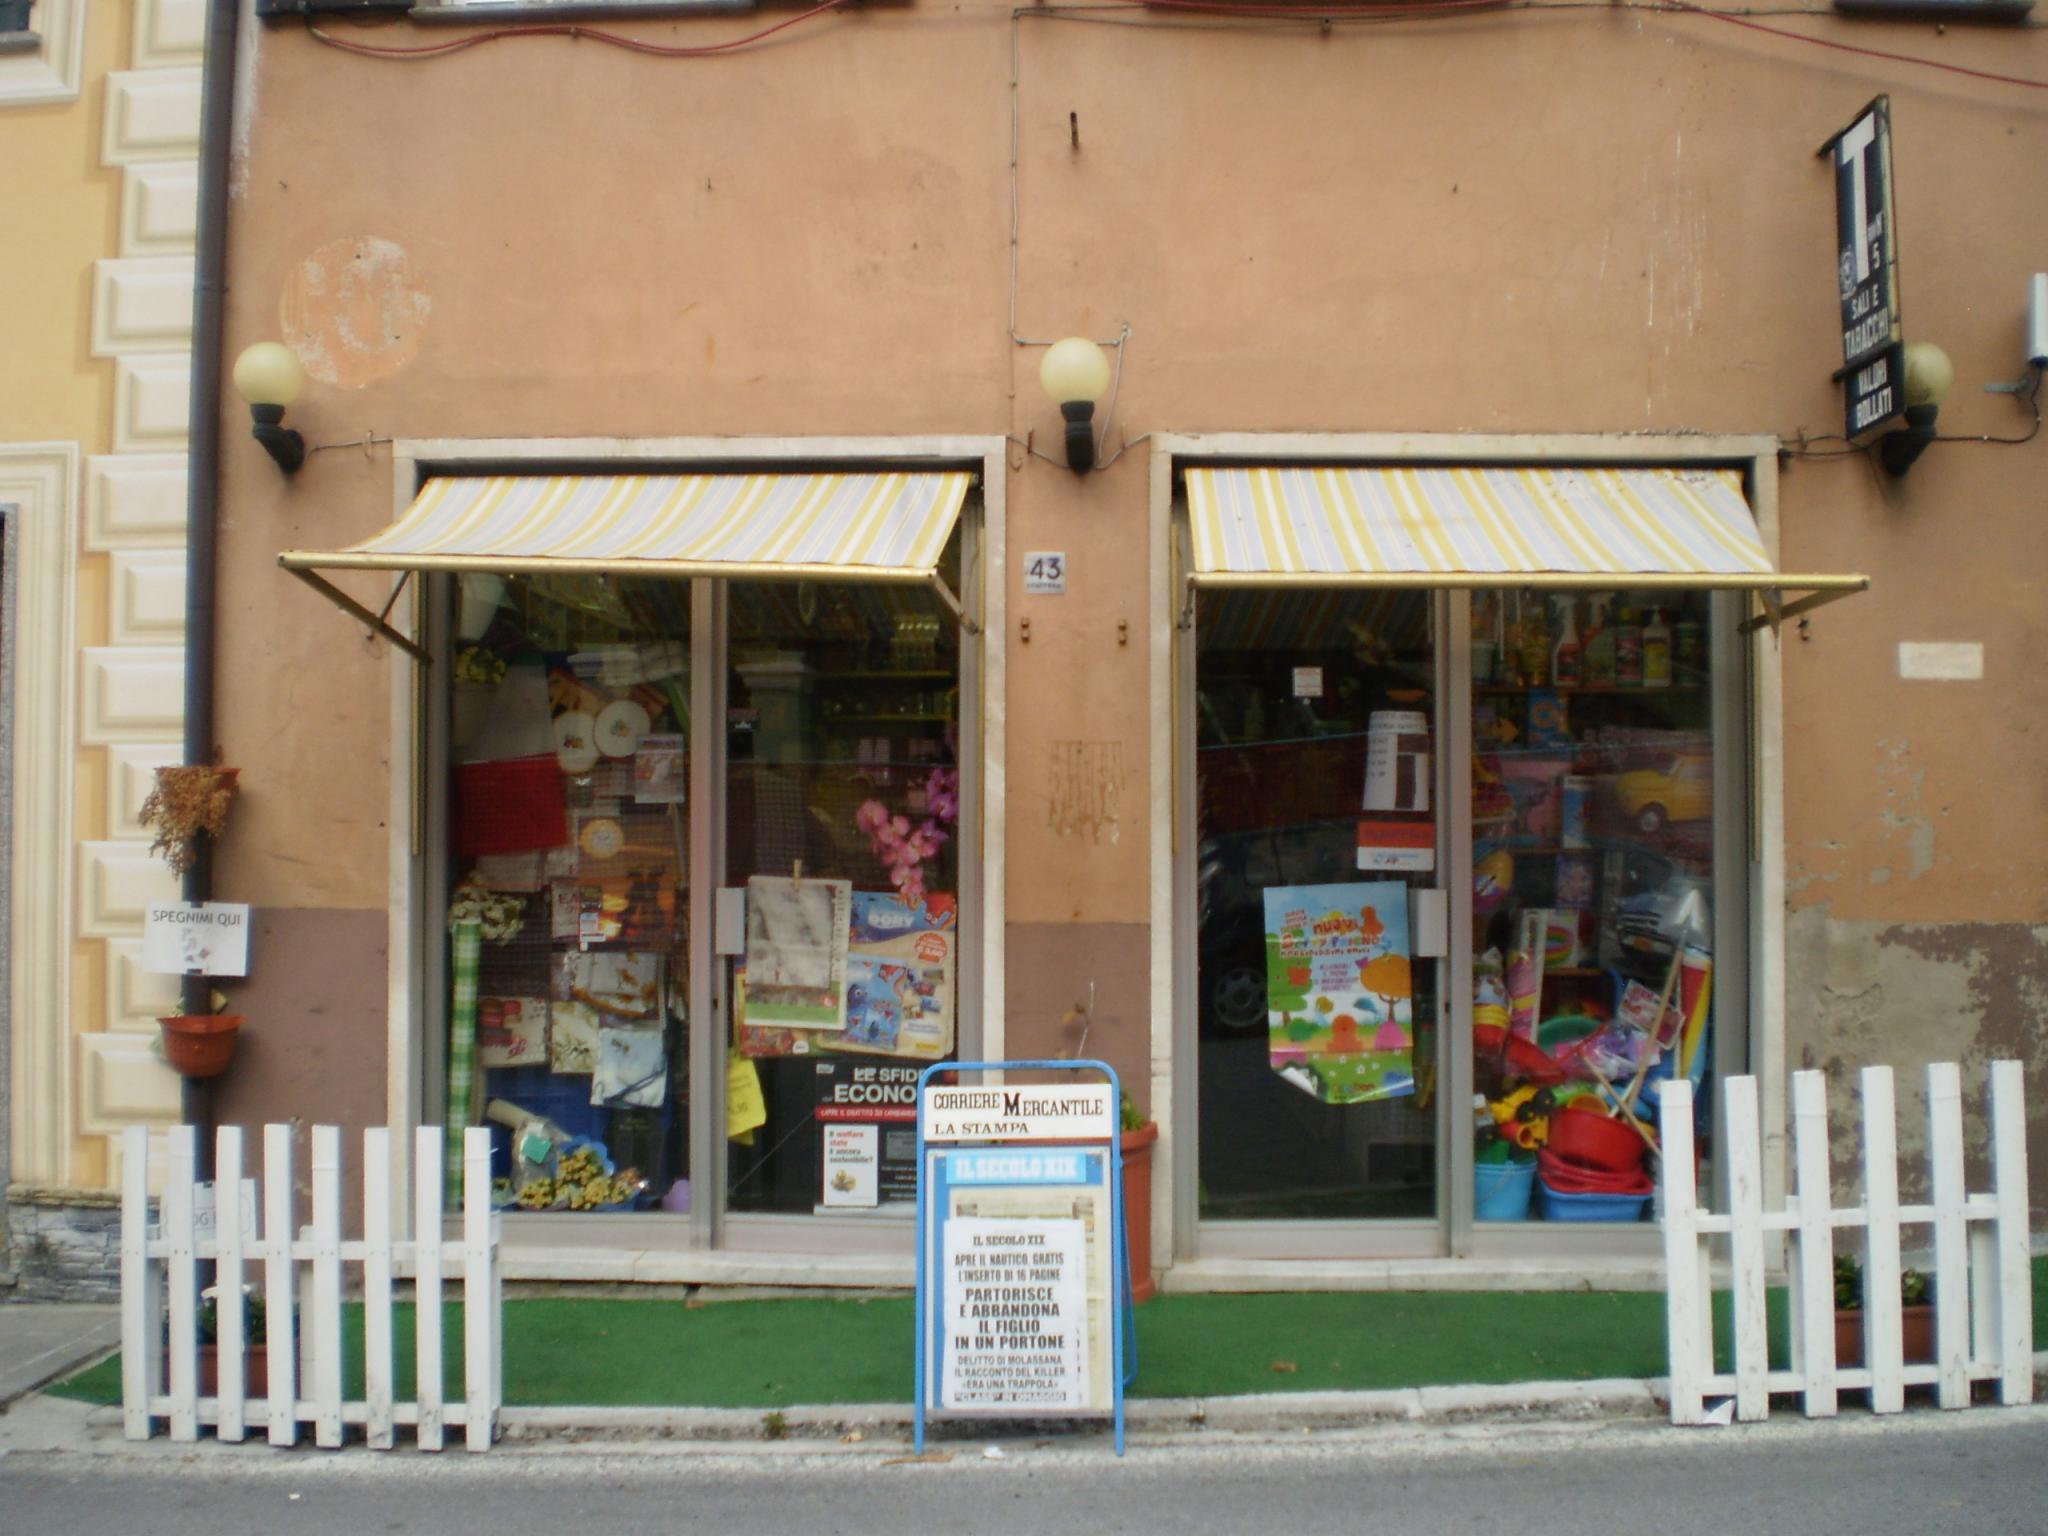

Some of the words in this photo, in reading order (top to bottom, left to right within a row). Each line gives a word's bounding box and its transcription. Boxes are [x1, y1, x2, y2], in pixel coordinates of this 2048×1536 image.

[1842, 111, 1876, 283] T
[1852, 287, 1869, 320] SALI
[1873, 283, 1879, 307] E
[1844, 307, 1889, 361] TABACCHI
[1858, 357, 1887, 396] VALORI
[1856, 385, 1892, 429] BOLLATI
[1029, 556, 1062, 581] 43
[152, 909, 213, 925] SPEGNIMI
[217, 912, 241, 928] QUI
[854, 1066, 876, 1083] LE
[833, 1083, 918, 1105] ECONO
[933, 1092, 1000, 1111] CORRIERE
[1003, 1092, 1104, 1117] MERCANTILE
[934, 1122, 956, 1136] LA
[961, 1121, 1030, 1136] STAMPA
[955, 1157, 975, 1180] IL
[976, 1157, 1041, 1180] SECOLO
[973, 1235, 984, 1247] IL
[985, 1234, 1026, 1247] SECOLO
[1028, 1234, 1046, 1246] XIX
[955, 1253, 976, 1267] APRE
[979, 1253, 986, 1267] IL
[989, 1253, 1029, 1267] NAUTICO
[1033, 1252, 1065, 1266] GRATIS
[958, 1268, 1001, 1283] L'INSERTO
[1004, 1269, 1014, 1281] DI
[1017, 1269, 1027, 1281] 16
[1029, 1268, 1061, 1281] PAGINE
[965, 1286, 1054, 1302] PARTORISCE
[960, 1304, 967, 1318] E
[971, 1303, 1060, 1318] ABBANDONA
[979, 1320, 990, 1334] IL
[996, 1319, 1041, 1334] FIGLIO
[955, 1336, 969, 1350] IN
[975, 1336, 994, 1350] UN
[1000, 1335, 1065, 1350] PORTONE
[958, 1355, 995, 1366] DELITTO
[997, 1356, 1006, 1366] DI
[1008, 1355, 1062, 1366] MOLASSANA
[954, 1367, 963, 1377] IL
[965, 1366, 1014, 1378] RACCONTO
[1015, 1366, 1032, 1378] DEL
[1034, 1366, 1066, 1377] KILLER
[987, 1379, 1005, 1389] UNA
